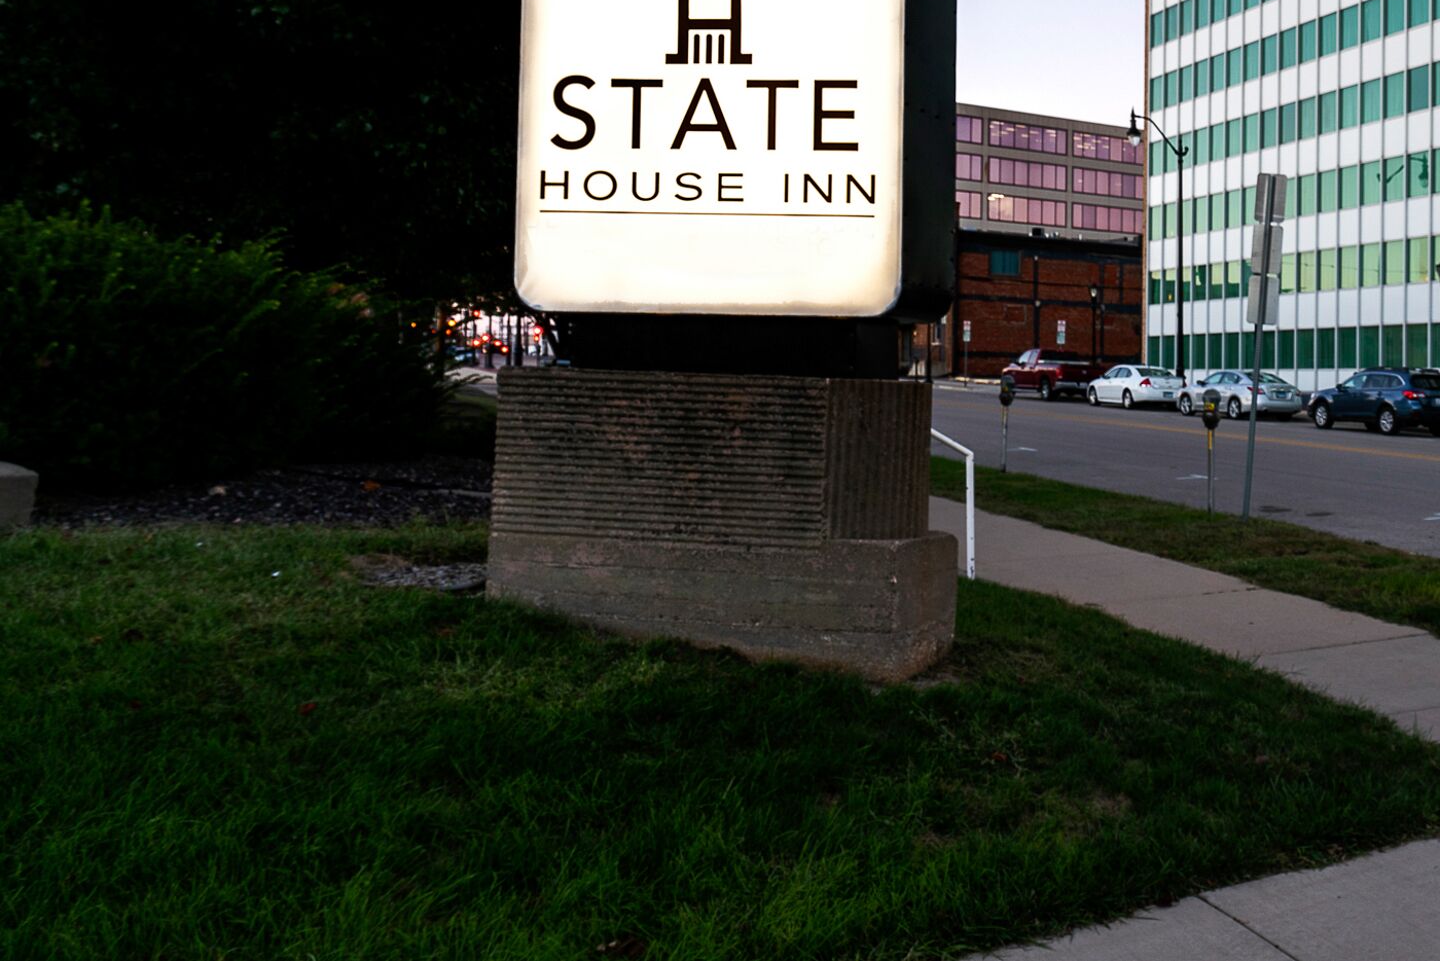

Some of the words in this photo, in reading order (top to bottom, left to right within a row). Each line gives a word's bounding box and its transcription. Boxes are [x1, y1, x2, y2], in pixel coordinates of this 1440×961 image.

[551, 74, 859, 152] STATE
[540, 170, 744, 202] HOUSE
[784, 173, 876, 205] INN
